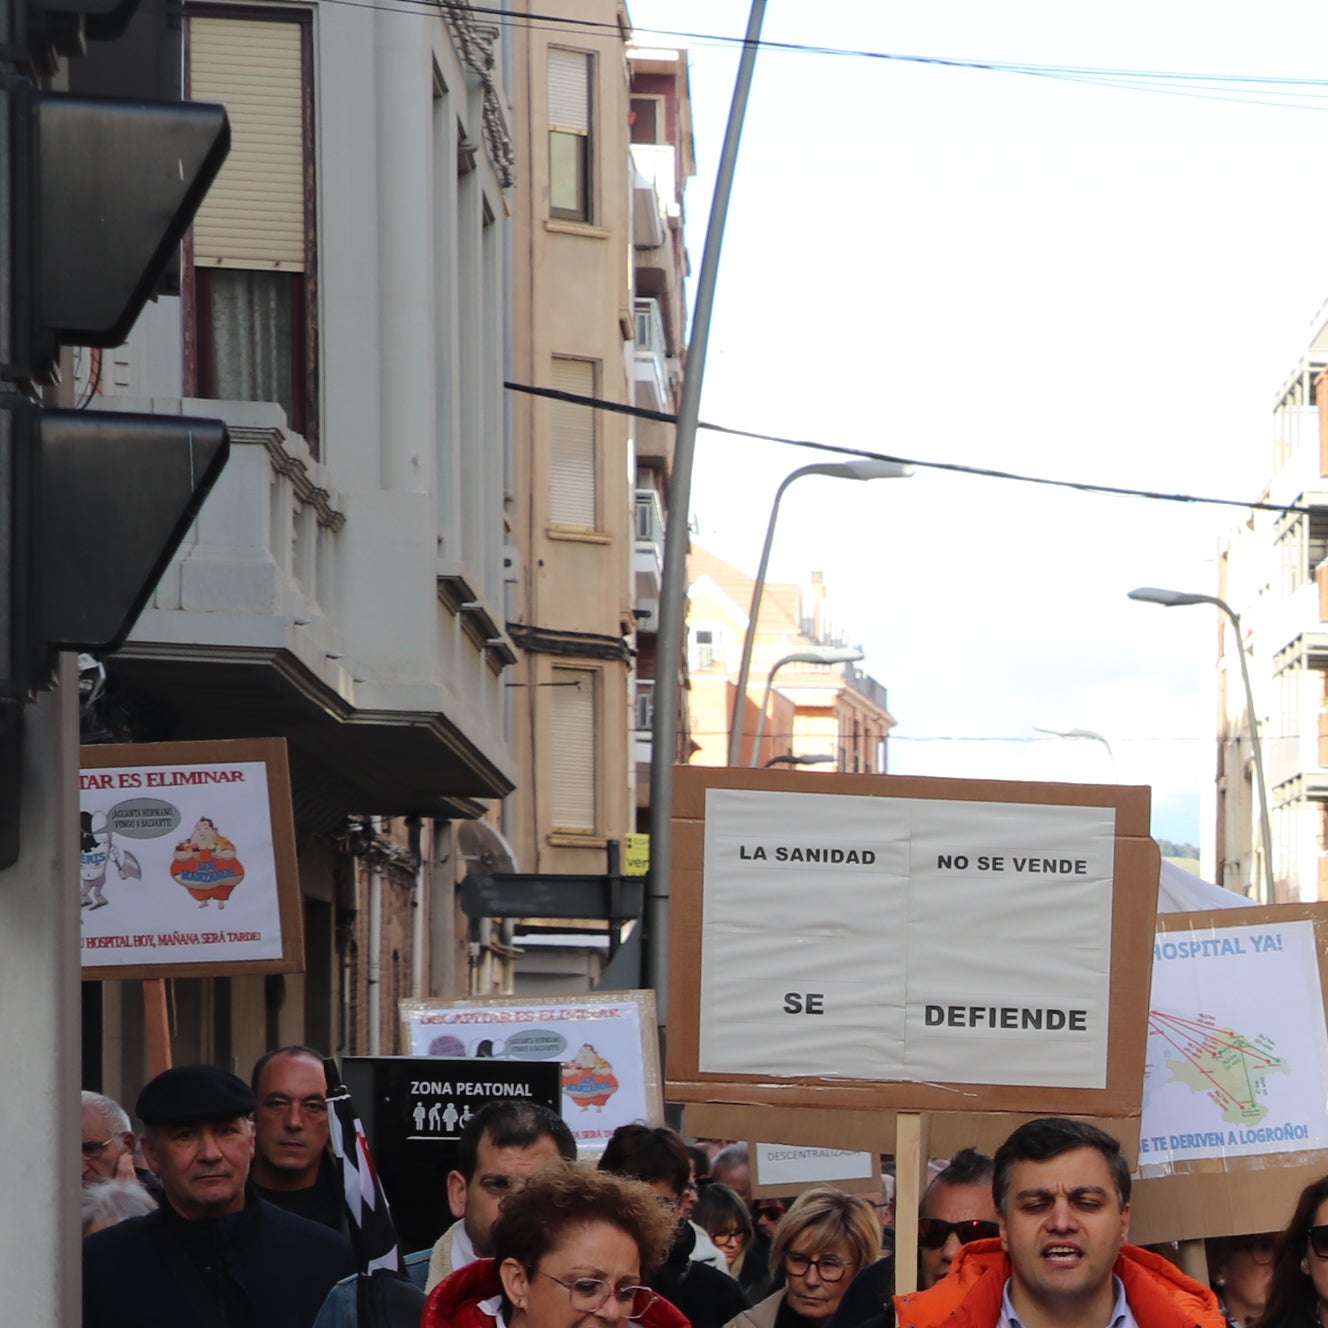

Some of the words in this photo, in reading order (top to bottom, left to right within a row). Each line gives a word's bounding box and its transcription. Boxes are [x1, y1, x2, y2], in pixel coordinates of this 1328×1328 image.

[118, 773, 142, 788] ES
[146, 770, 245, 787] ELIMINAR
[739, 845, 768, 861] LA
[775, 846, 876, 865] SANIDAD
[937, 855, 969, 871] NO
[977, 856, 1005, 872] SE
[1013, 857, 1088, 875] VENDE
[87, 936, 132, 949] HOSPITAL
[157, 930, 200, 946] MAÑANA
[1250, 934, 1283, 953] YA!
[783, 992, 825, 1015] SE
[924, 1004, 1088, 1031] DEFIENDE
[410, 1081, 452, 1096] ZONA
[456, 1082, 532, 1097] PEATONAL
[1151, 1137, 1168, 1151] TE
[1170, 1131, 1225, 1150] DERIVEN
[1228, 1130, 1238, 1146] A
[1239, 1122, 1309, 1145] LOGROÑO!
